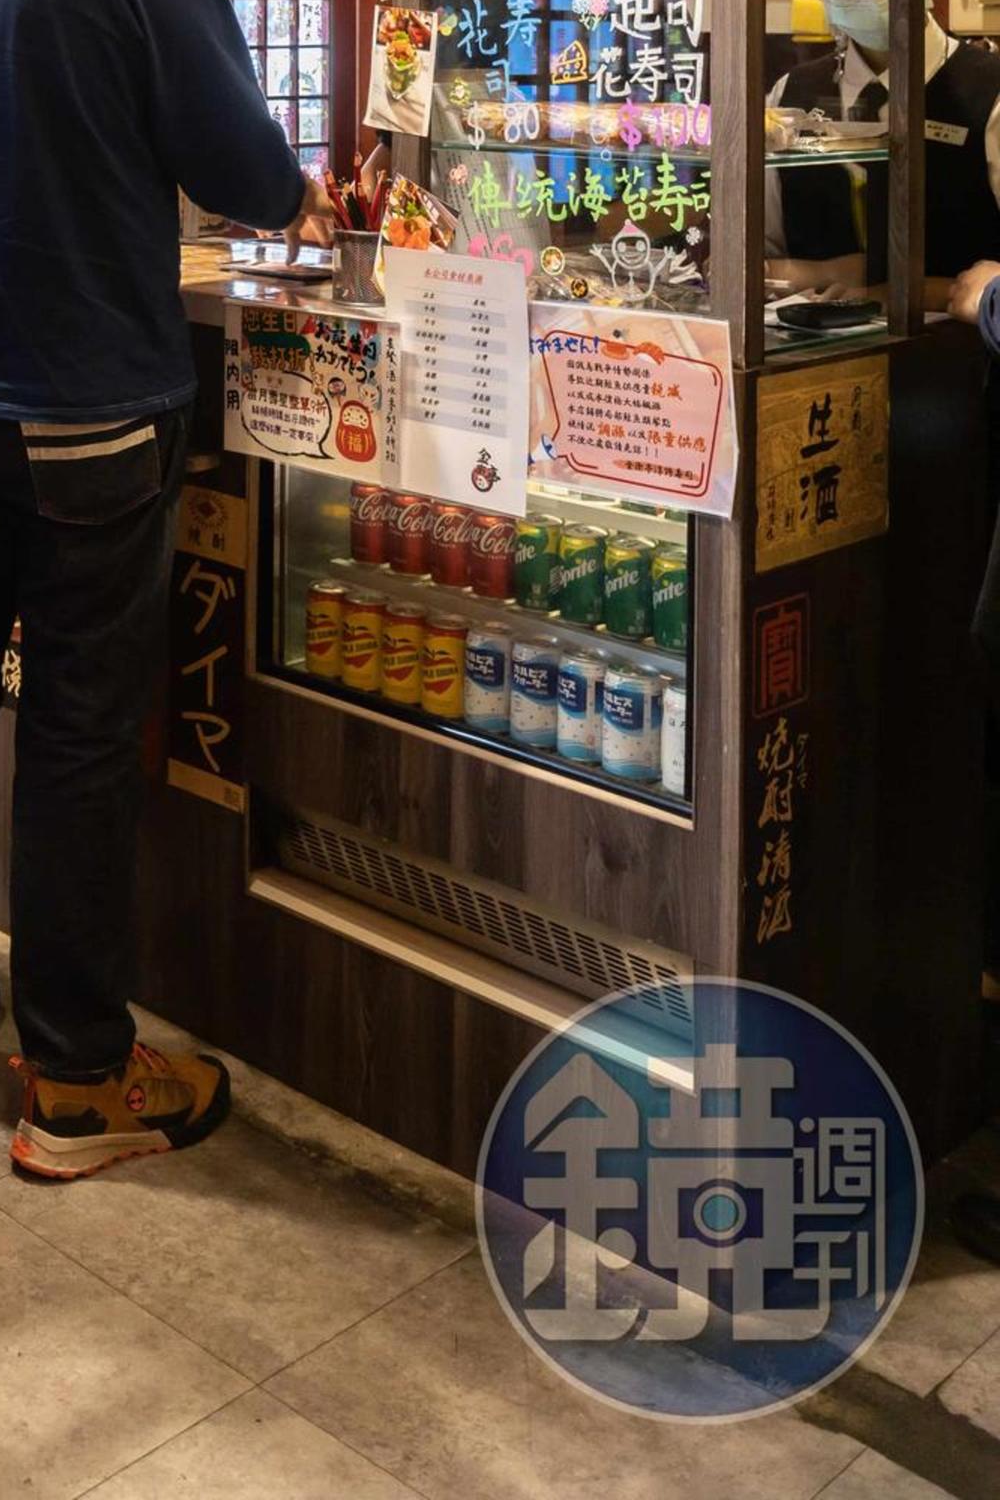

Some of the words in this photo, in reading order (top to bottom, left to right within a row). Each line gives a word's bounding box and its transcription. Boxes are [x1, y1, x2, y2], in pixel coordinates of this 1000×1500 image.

[590, 44, 704, 108] 花寿司
[653, 580, 684, 608] prite
[180, 561, 236, 773] ダイマ
